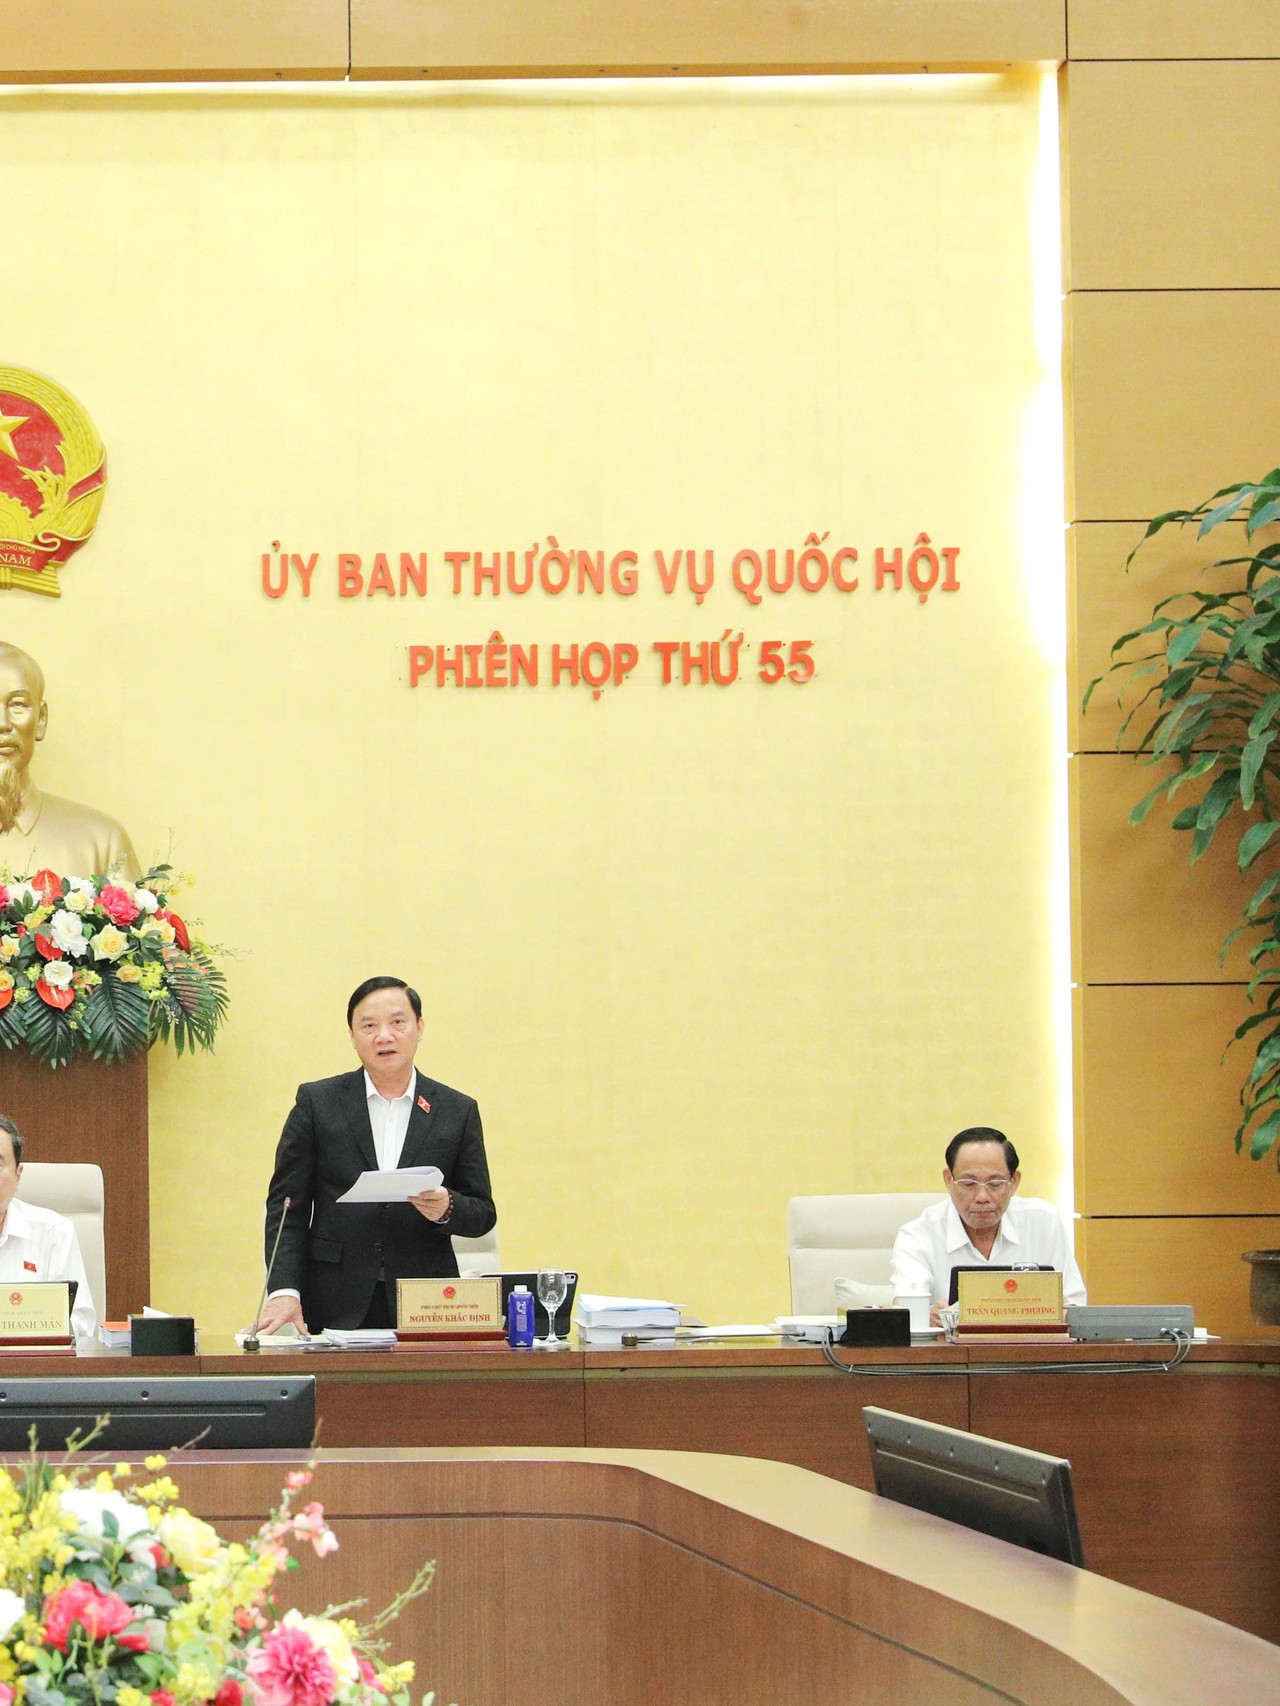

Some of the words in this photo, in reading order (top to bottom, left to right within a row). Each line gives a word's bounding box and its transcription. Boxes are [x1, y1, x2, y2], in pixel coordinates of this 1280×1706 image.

[262, 540, 319, 598] ỦY
[338, 553, 427, 597] BAN
[445, 536, 638, 596] THƯỜNG
[655, 549, 714, 604] VỤ
[732, 532, 858, 605] QUỐC
[875, 532, 960, 603] HỘI
[409, 630, 539, 687] PHIÊN
[551, 641, 639, 700] HỌP
[652, 629, 744, 687] THỨ
[759, 640, 815, 684] 55
[1, 1320, 37, 1330] THANH
[990, 1307, 1019, 1316] QUANG
